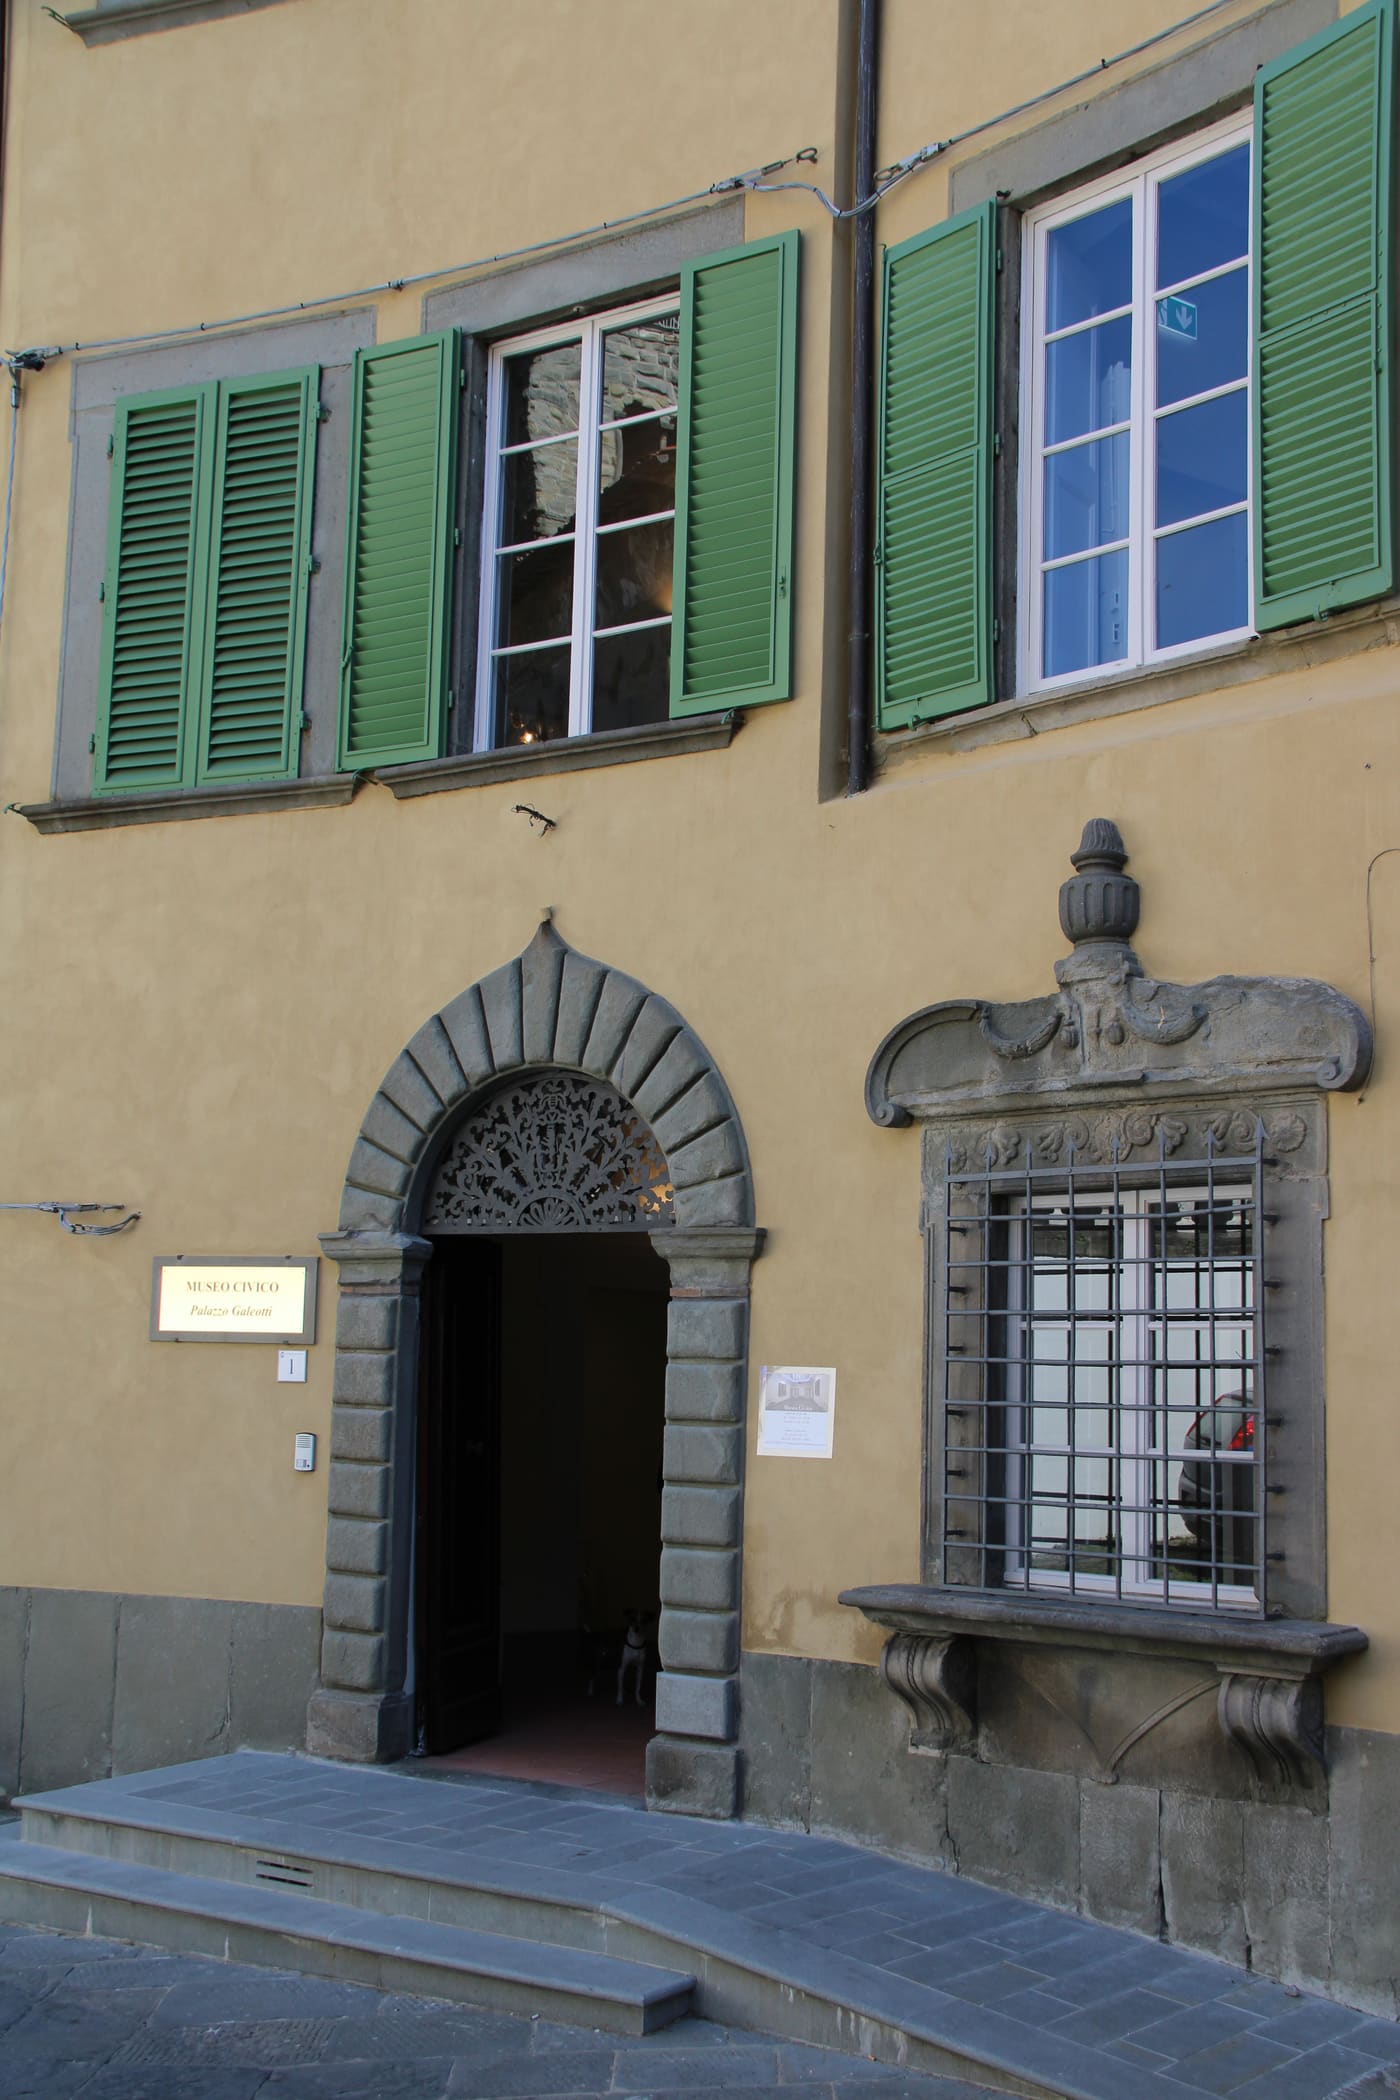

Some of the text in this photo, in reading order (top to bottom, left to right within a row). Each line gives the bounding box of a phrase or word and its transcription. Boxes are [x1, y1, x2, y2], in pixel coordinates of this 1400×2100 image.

[186, 1281, 280, 1293] MUSEO CIVICO
[190, 1305, 273, 1317] Palazzo Galeotti
